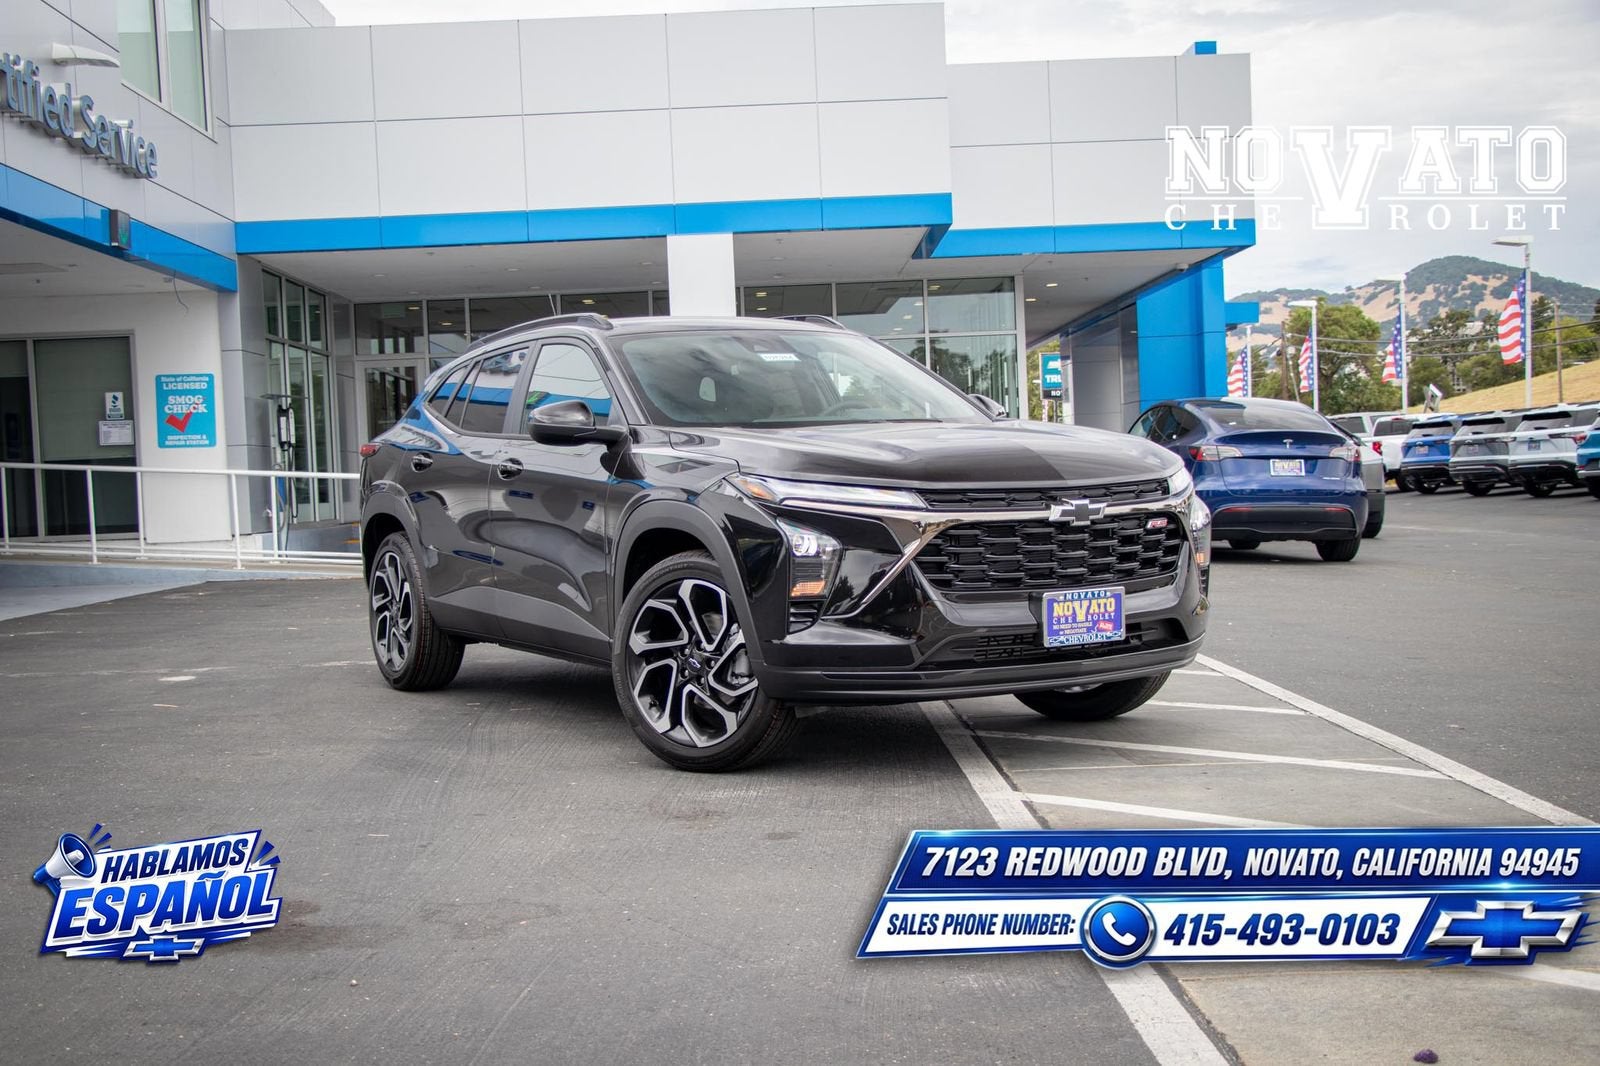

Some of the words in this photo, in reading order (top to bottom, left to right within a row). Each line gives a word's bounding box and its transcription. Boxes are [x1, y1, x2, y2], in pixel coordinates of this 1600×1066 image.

[80, 95, 158, 179] Service
[163, 382, 208, 390] LICENSED
[167, 395, 204, 404] SMOG
[164, 404, 208, 413] CHECK
[1066, 591, 1105, 600] NOVATO
[1053, 597, 1115, 622] NOVATO
[1064, 632, 1106, 644] CHEVROLET
